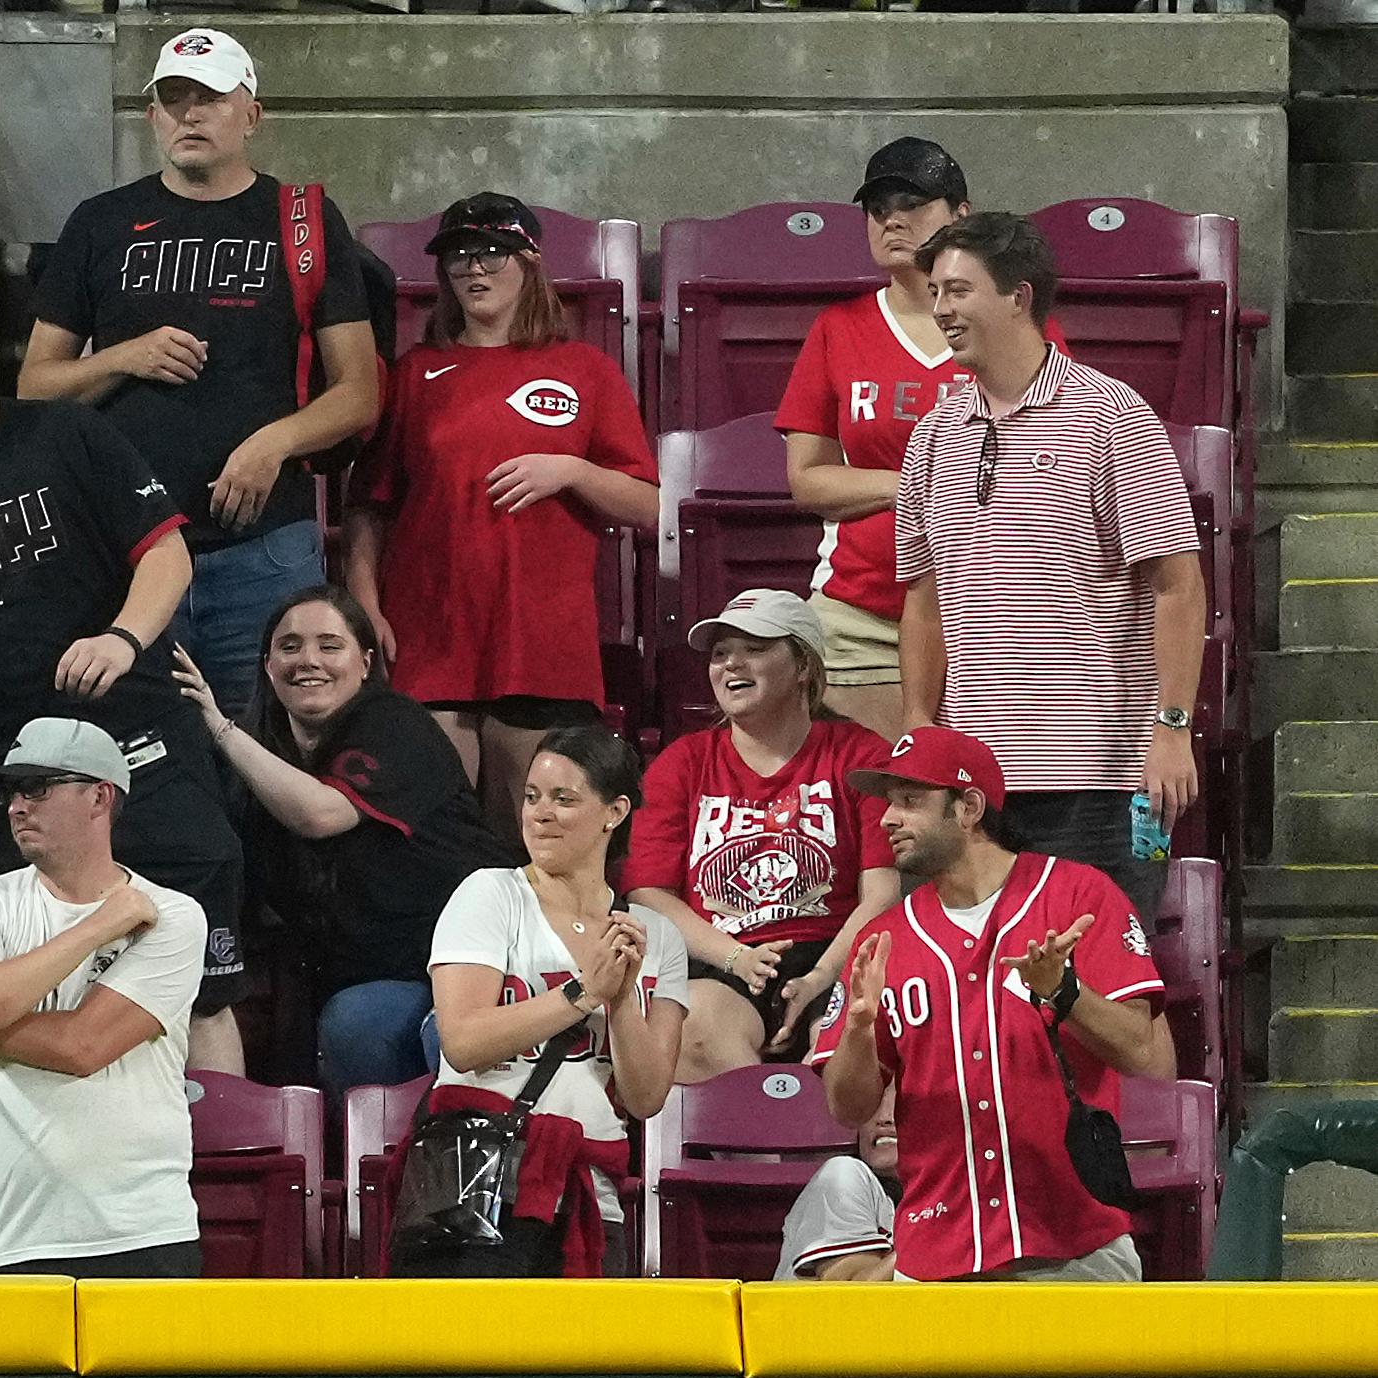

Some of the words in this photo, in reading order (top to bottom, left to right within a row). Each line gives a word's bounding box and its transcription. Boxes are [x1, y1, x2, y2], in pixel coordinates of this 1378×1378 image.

[799, 217, 811, 230] 3
[1100, 213, 1110, 225] 4
[527, 394, 580, 415] REDS
[891, 734, 914, 758] C
[880, 976, 930, 1038] 30
[775, 1079, 787, 1093] 3
